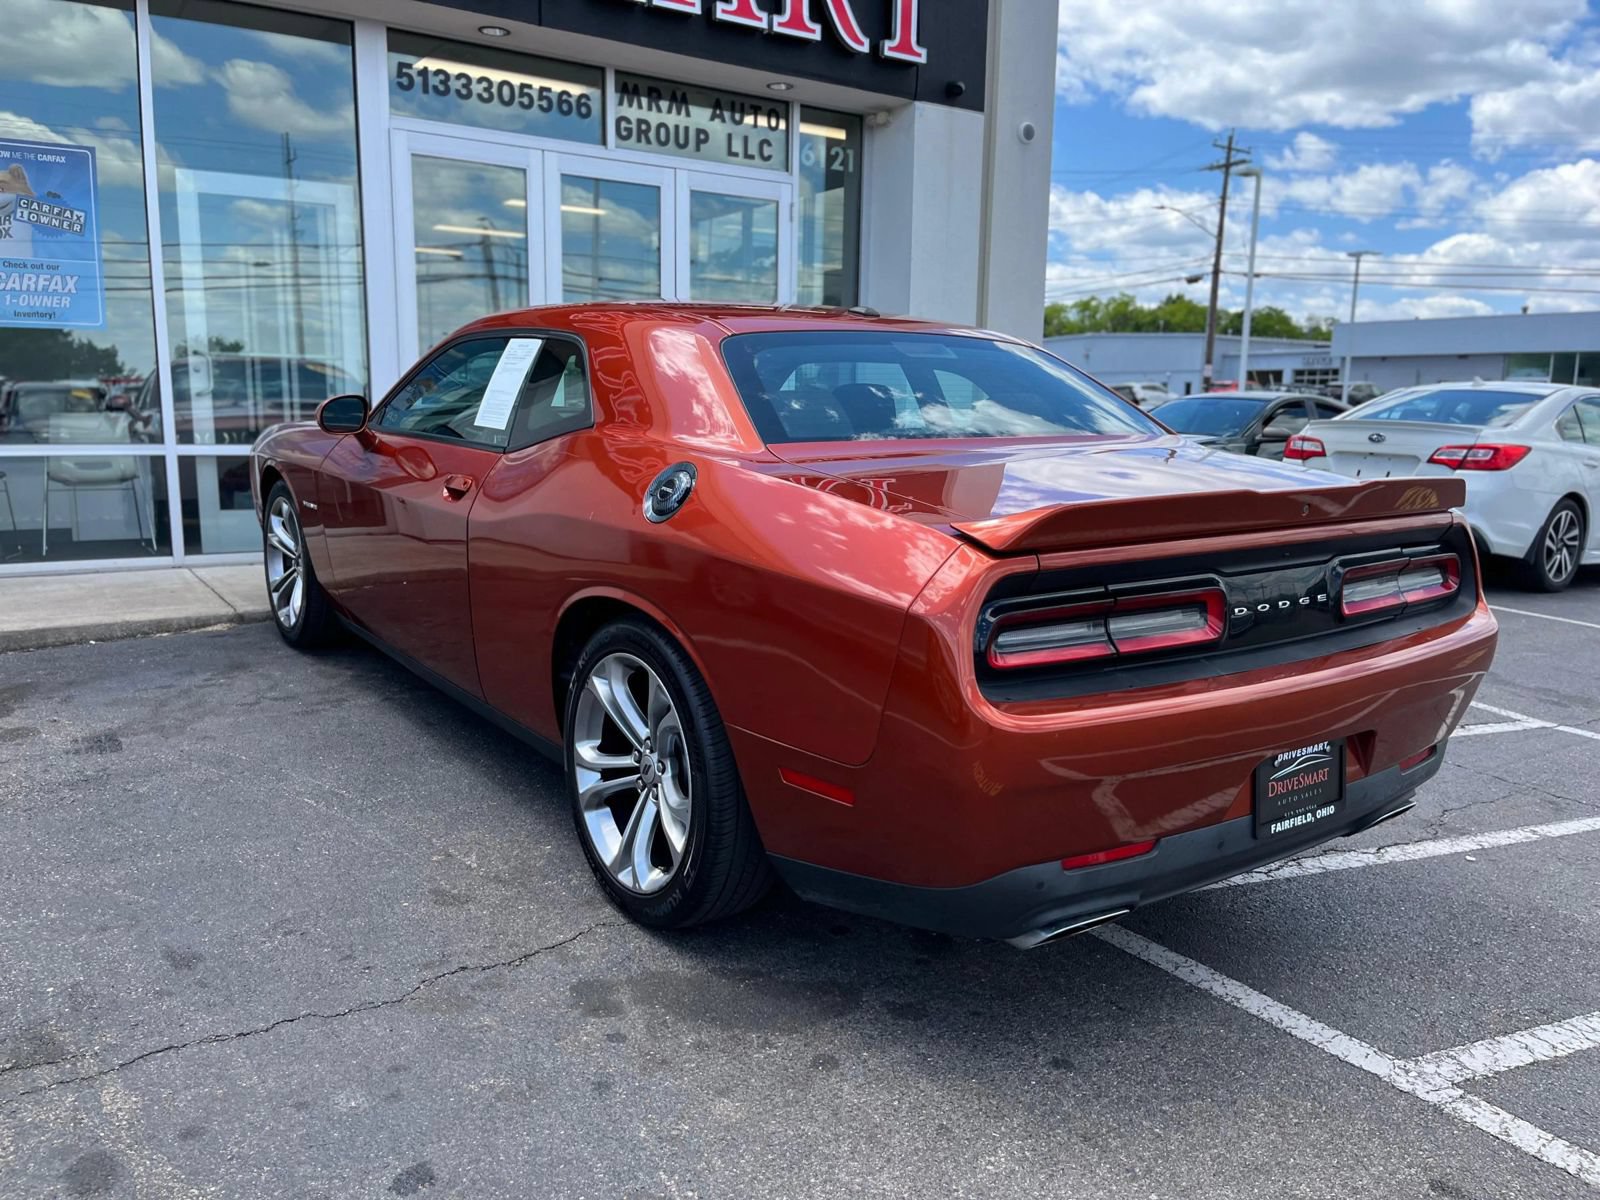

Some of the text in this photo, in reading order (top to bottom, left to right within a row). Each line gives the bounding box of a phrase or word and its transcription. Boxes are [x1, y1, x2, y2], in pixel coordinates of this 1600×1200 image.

[396, 61, 592, 119] 5133305566
[617, 81, 780, 132] MRM AUTO
[615, 115, 773, 162] GROUP LLC
[12, 151, 22, 160] ME
[23, 152, 36, 160] THE
[37, 153, 66, 163] CARFAX
[20, 199, 83, 222] CARFAX
[30, 213, 81, 232] OWNER
[2, 260, 28, 269] Check
[5, 294, 71, 308] 1-OWNER
[14, 310, 56, 320] Inventory!
[1234, 594, 1327, 615] DODGE
[1277, 741, 1328, 762] DRIVESMART
[1271, 812, 1315, 834] FAIRFIELD,
[1316, 805, 1335, 819] OHIO
